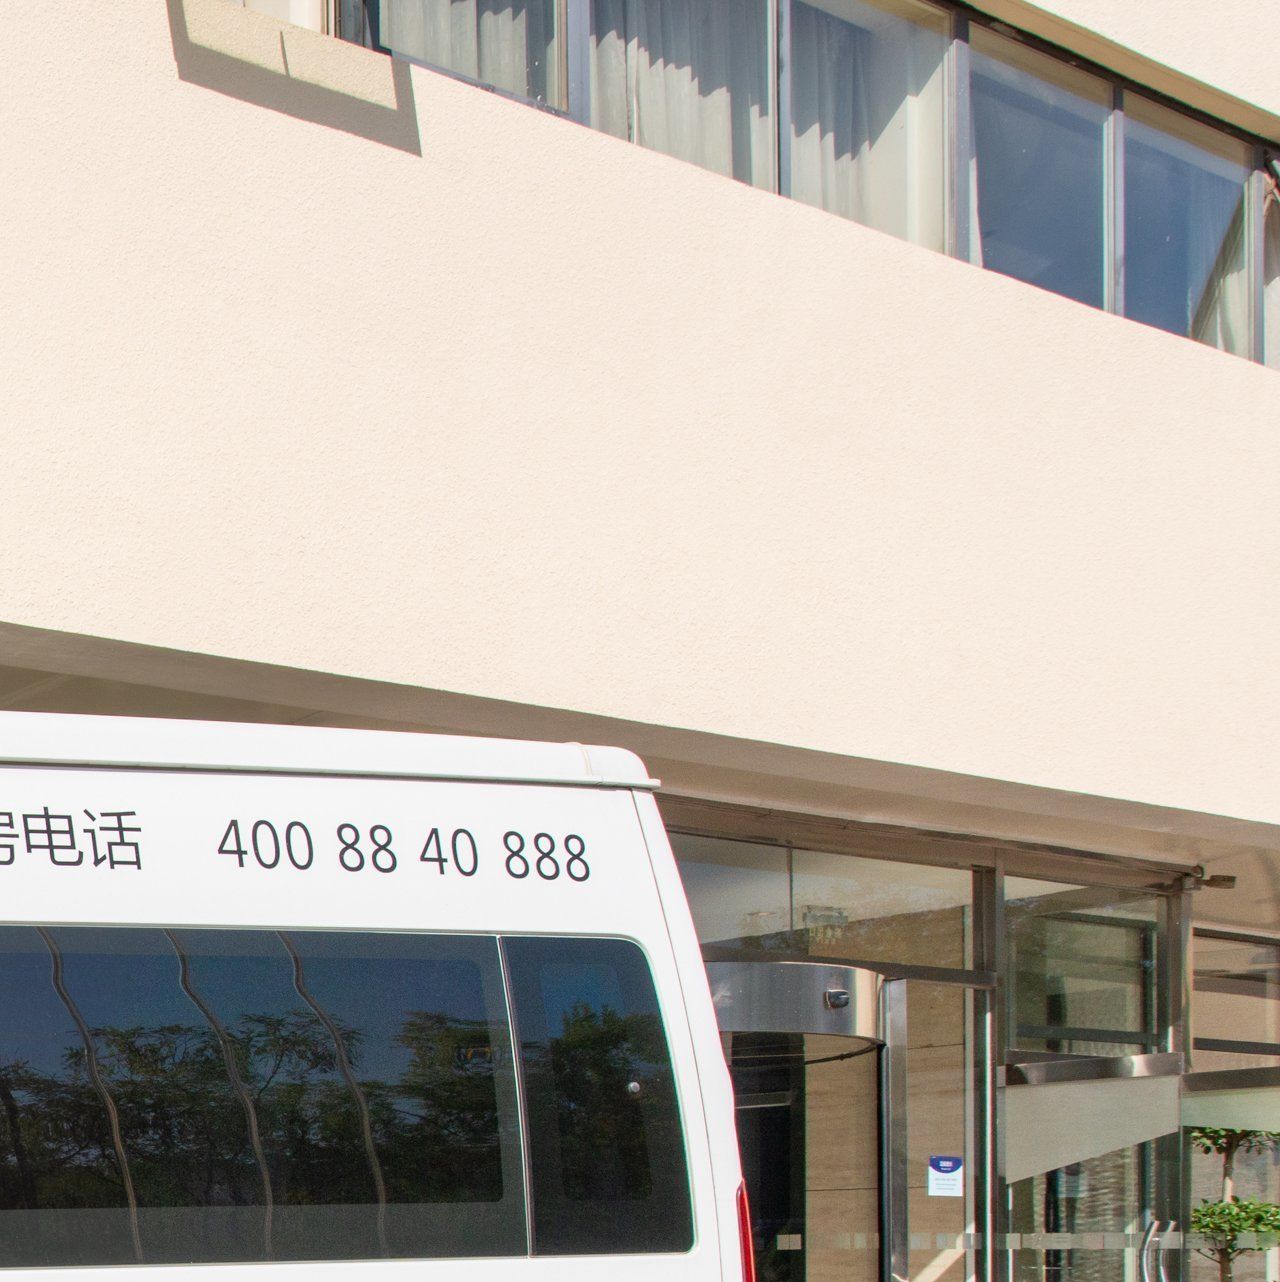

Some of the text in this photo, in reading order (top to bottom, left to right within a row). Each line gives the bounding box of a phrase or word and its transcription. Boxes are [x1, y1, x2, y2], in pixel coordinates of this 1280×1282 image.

[217, 819, 314, 871] 400
[336, 823, 397, 874] 88
[419, 827, 478, 877] 40
[502, 830, 590, 882] 888
